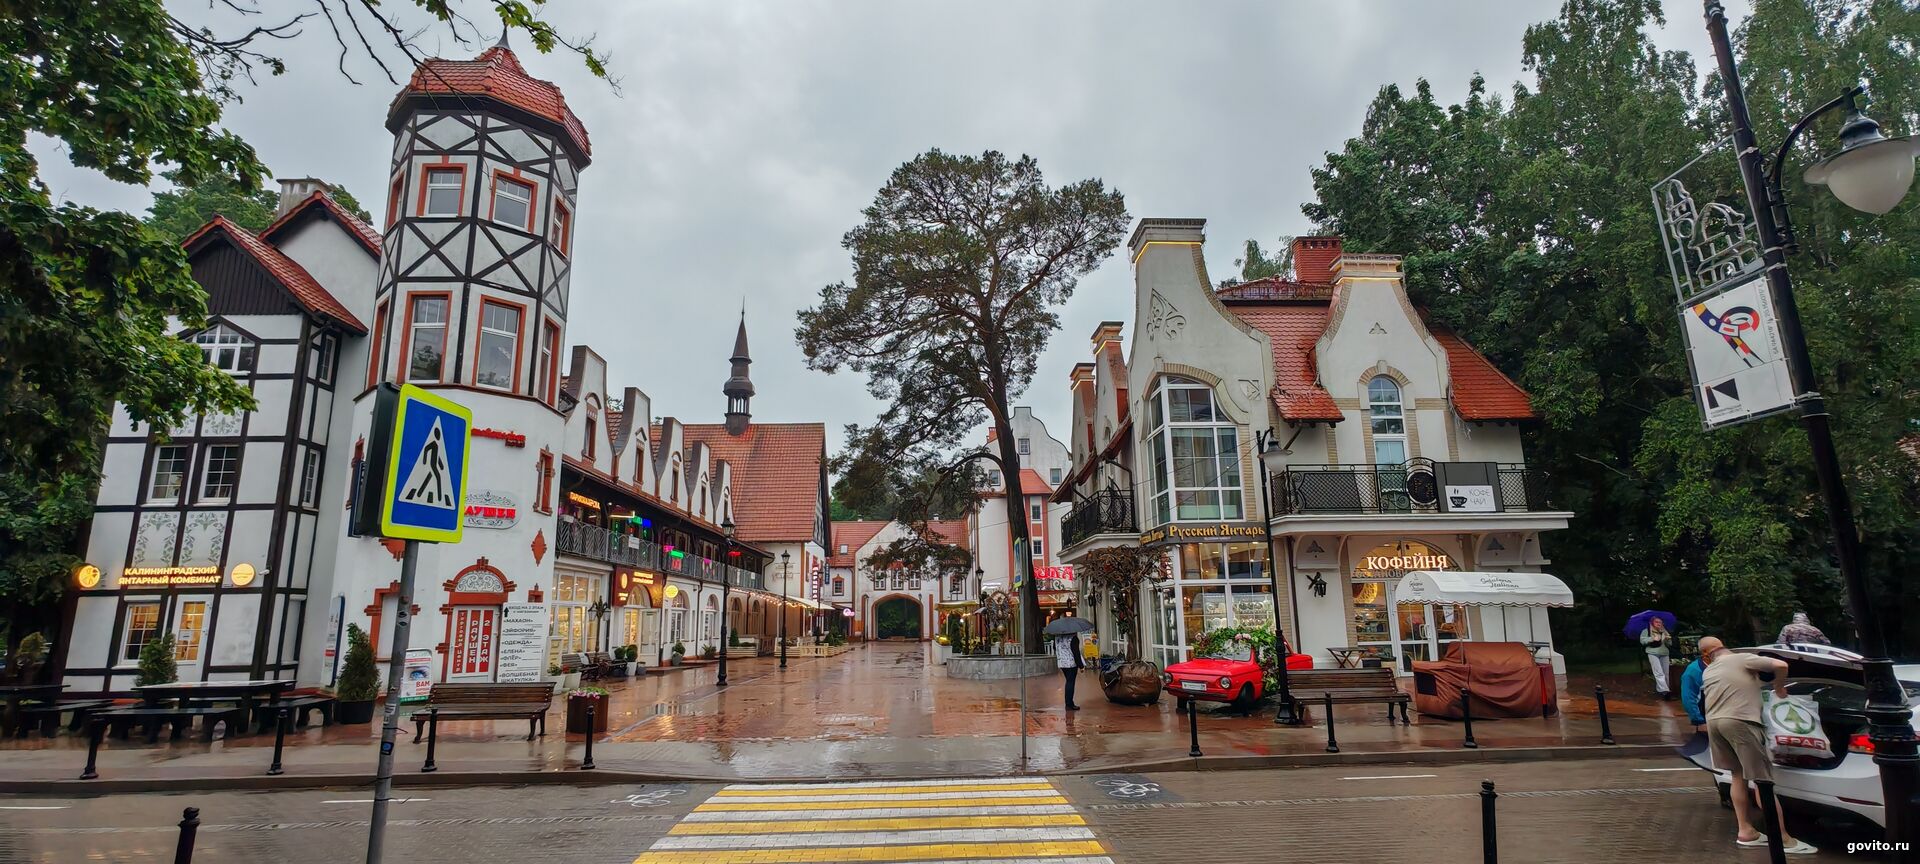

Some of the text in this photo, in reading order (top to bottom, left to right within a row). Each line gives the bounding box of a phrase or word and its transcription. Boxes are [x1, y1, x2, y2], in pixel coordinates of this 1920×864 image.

[464, 505, 516, 519] АУШЕН
[1169, 523, 1265, 540] Русский Янтарь
[1367, 553, 1449, 570] КОФЕЙНЯ
[124, 566, 217, 576] КАЛИНИНГРАДСКИЙ
[118, 575, 221, 585] ЯНТАРНЫЙ КОМБИНАТ
[469, 620, 479, 663] РАУШЕН
[480, 634, 489, 663] ЭТАЖ
[1777, 736, 1825, 749] SPAR
